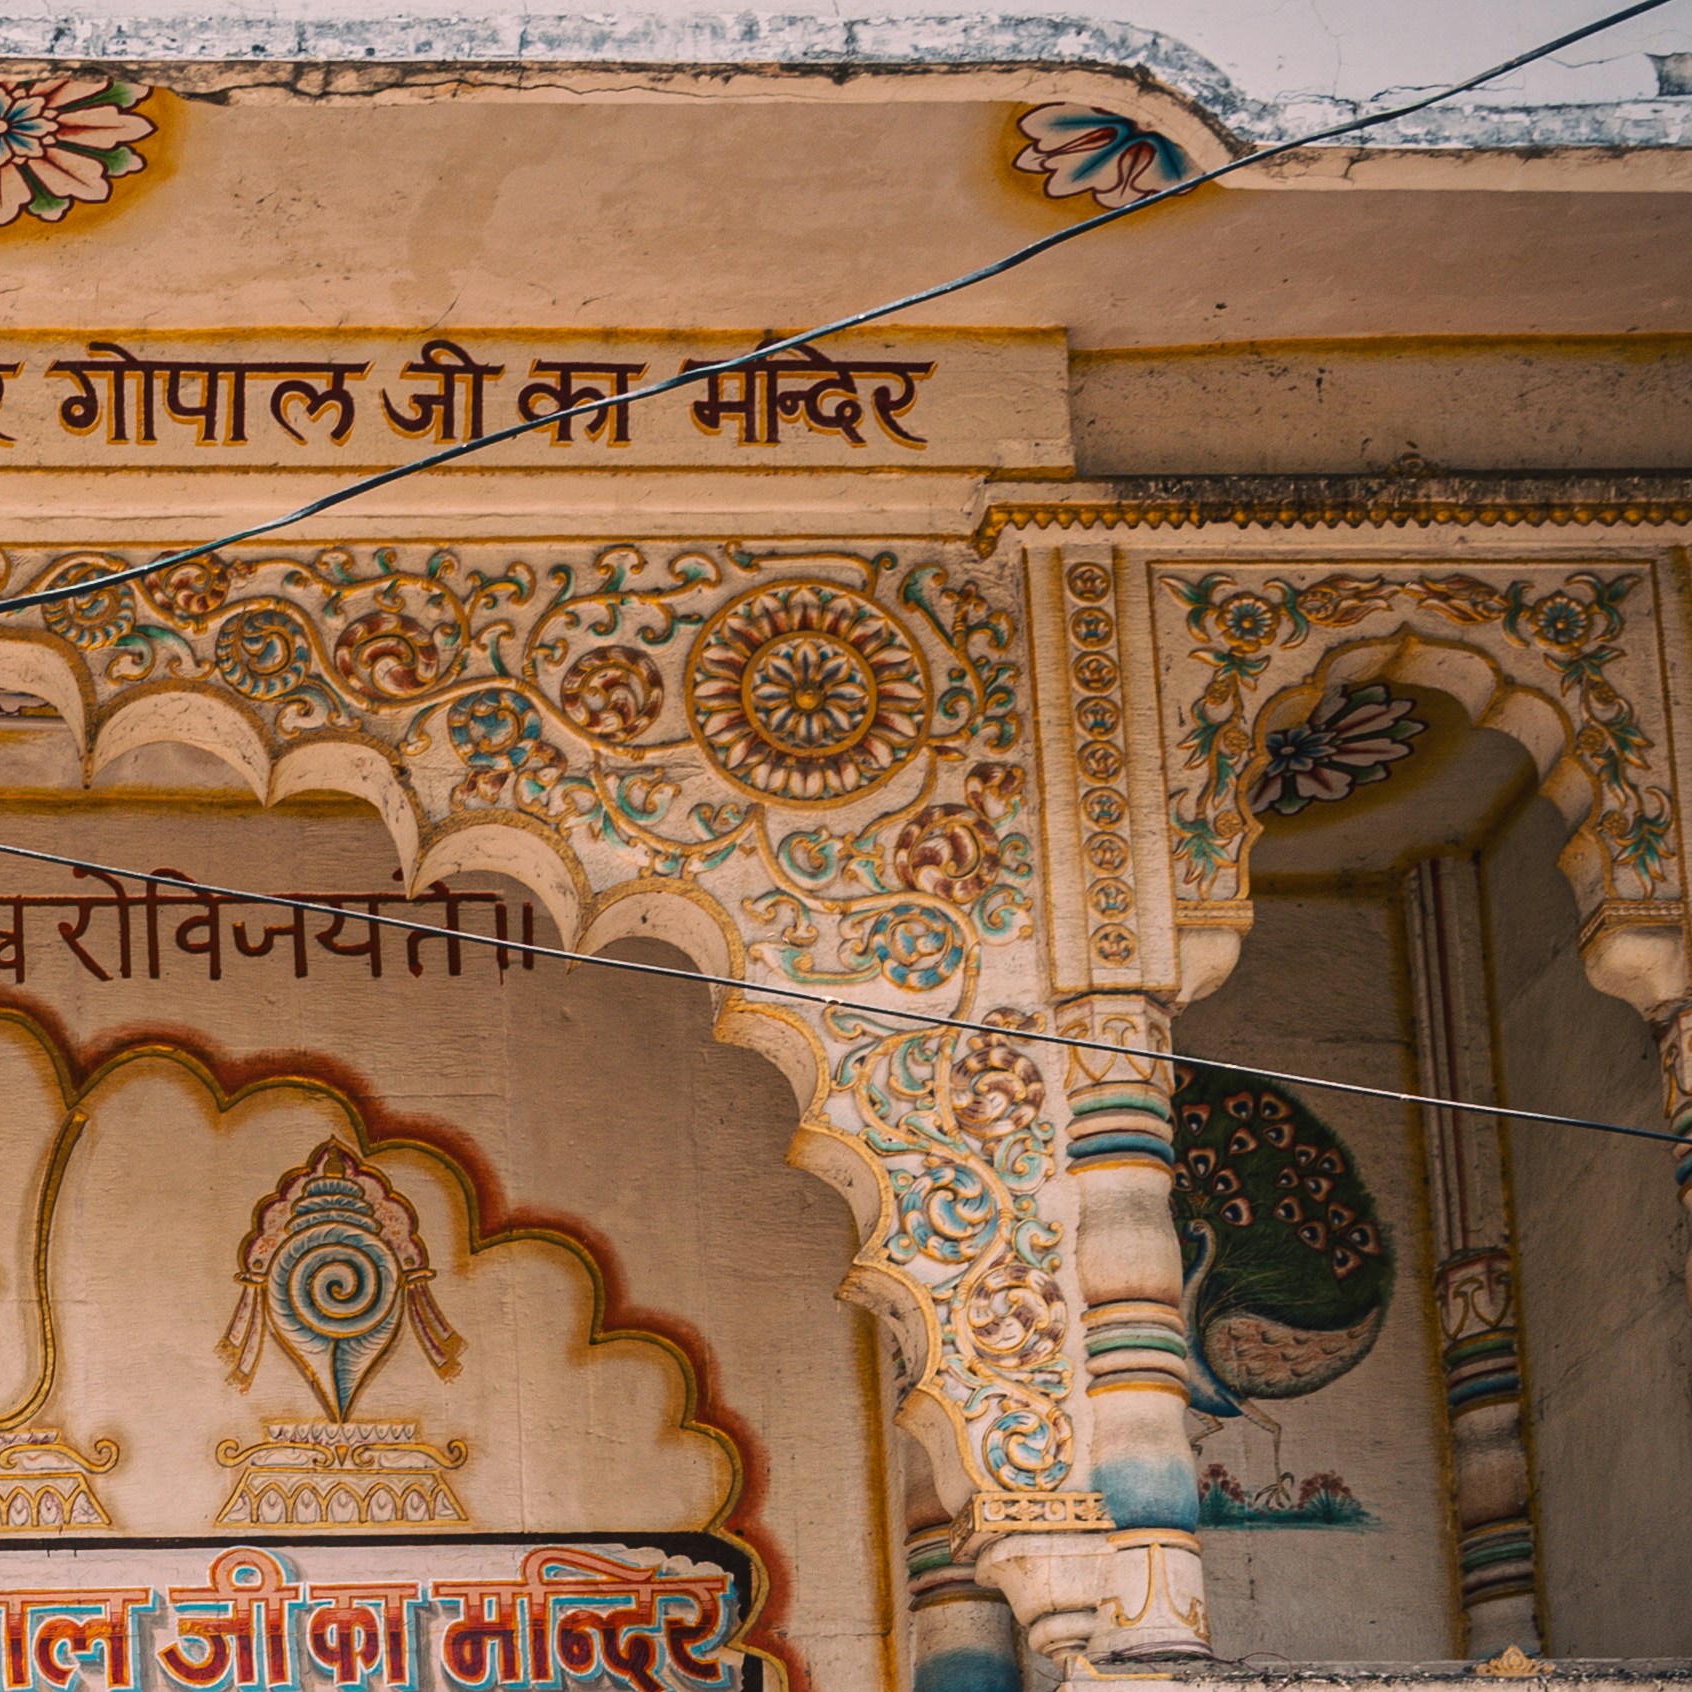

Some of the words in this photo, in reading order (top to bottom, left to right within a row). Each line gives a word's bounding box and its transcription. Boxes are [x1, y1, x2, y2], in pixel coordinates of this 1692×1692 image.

[44, 340, 376, 450] गोपाल
[380, 338, 505, 447] जी
[516, 358, 650, 447] का
[688, 335, 936, 450] मन्दिर
[307, 1579, 420, 1692] का
